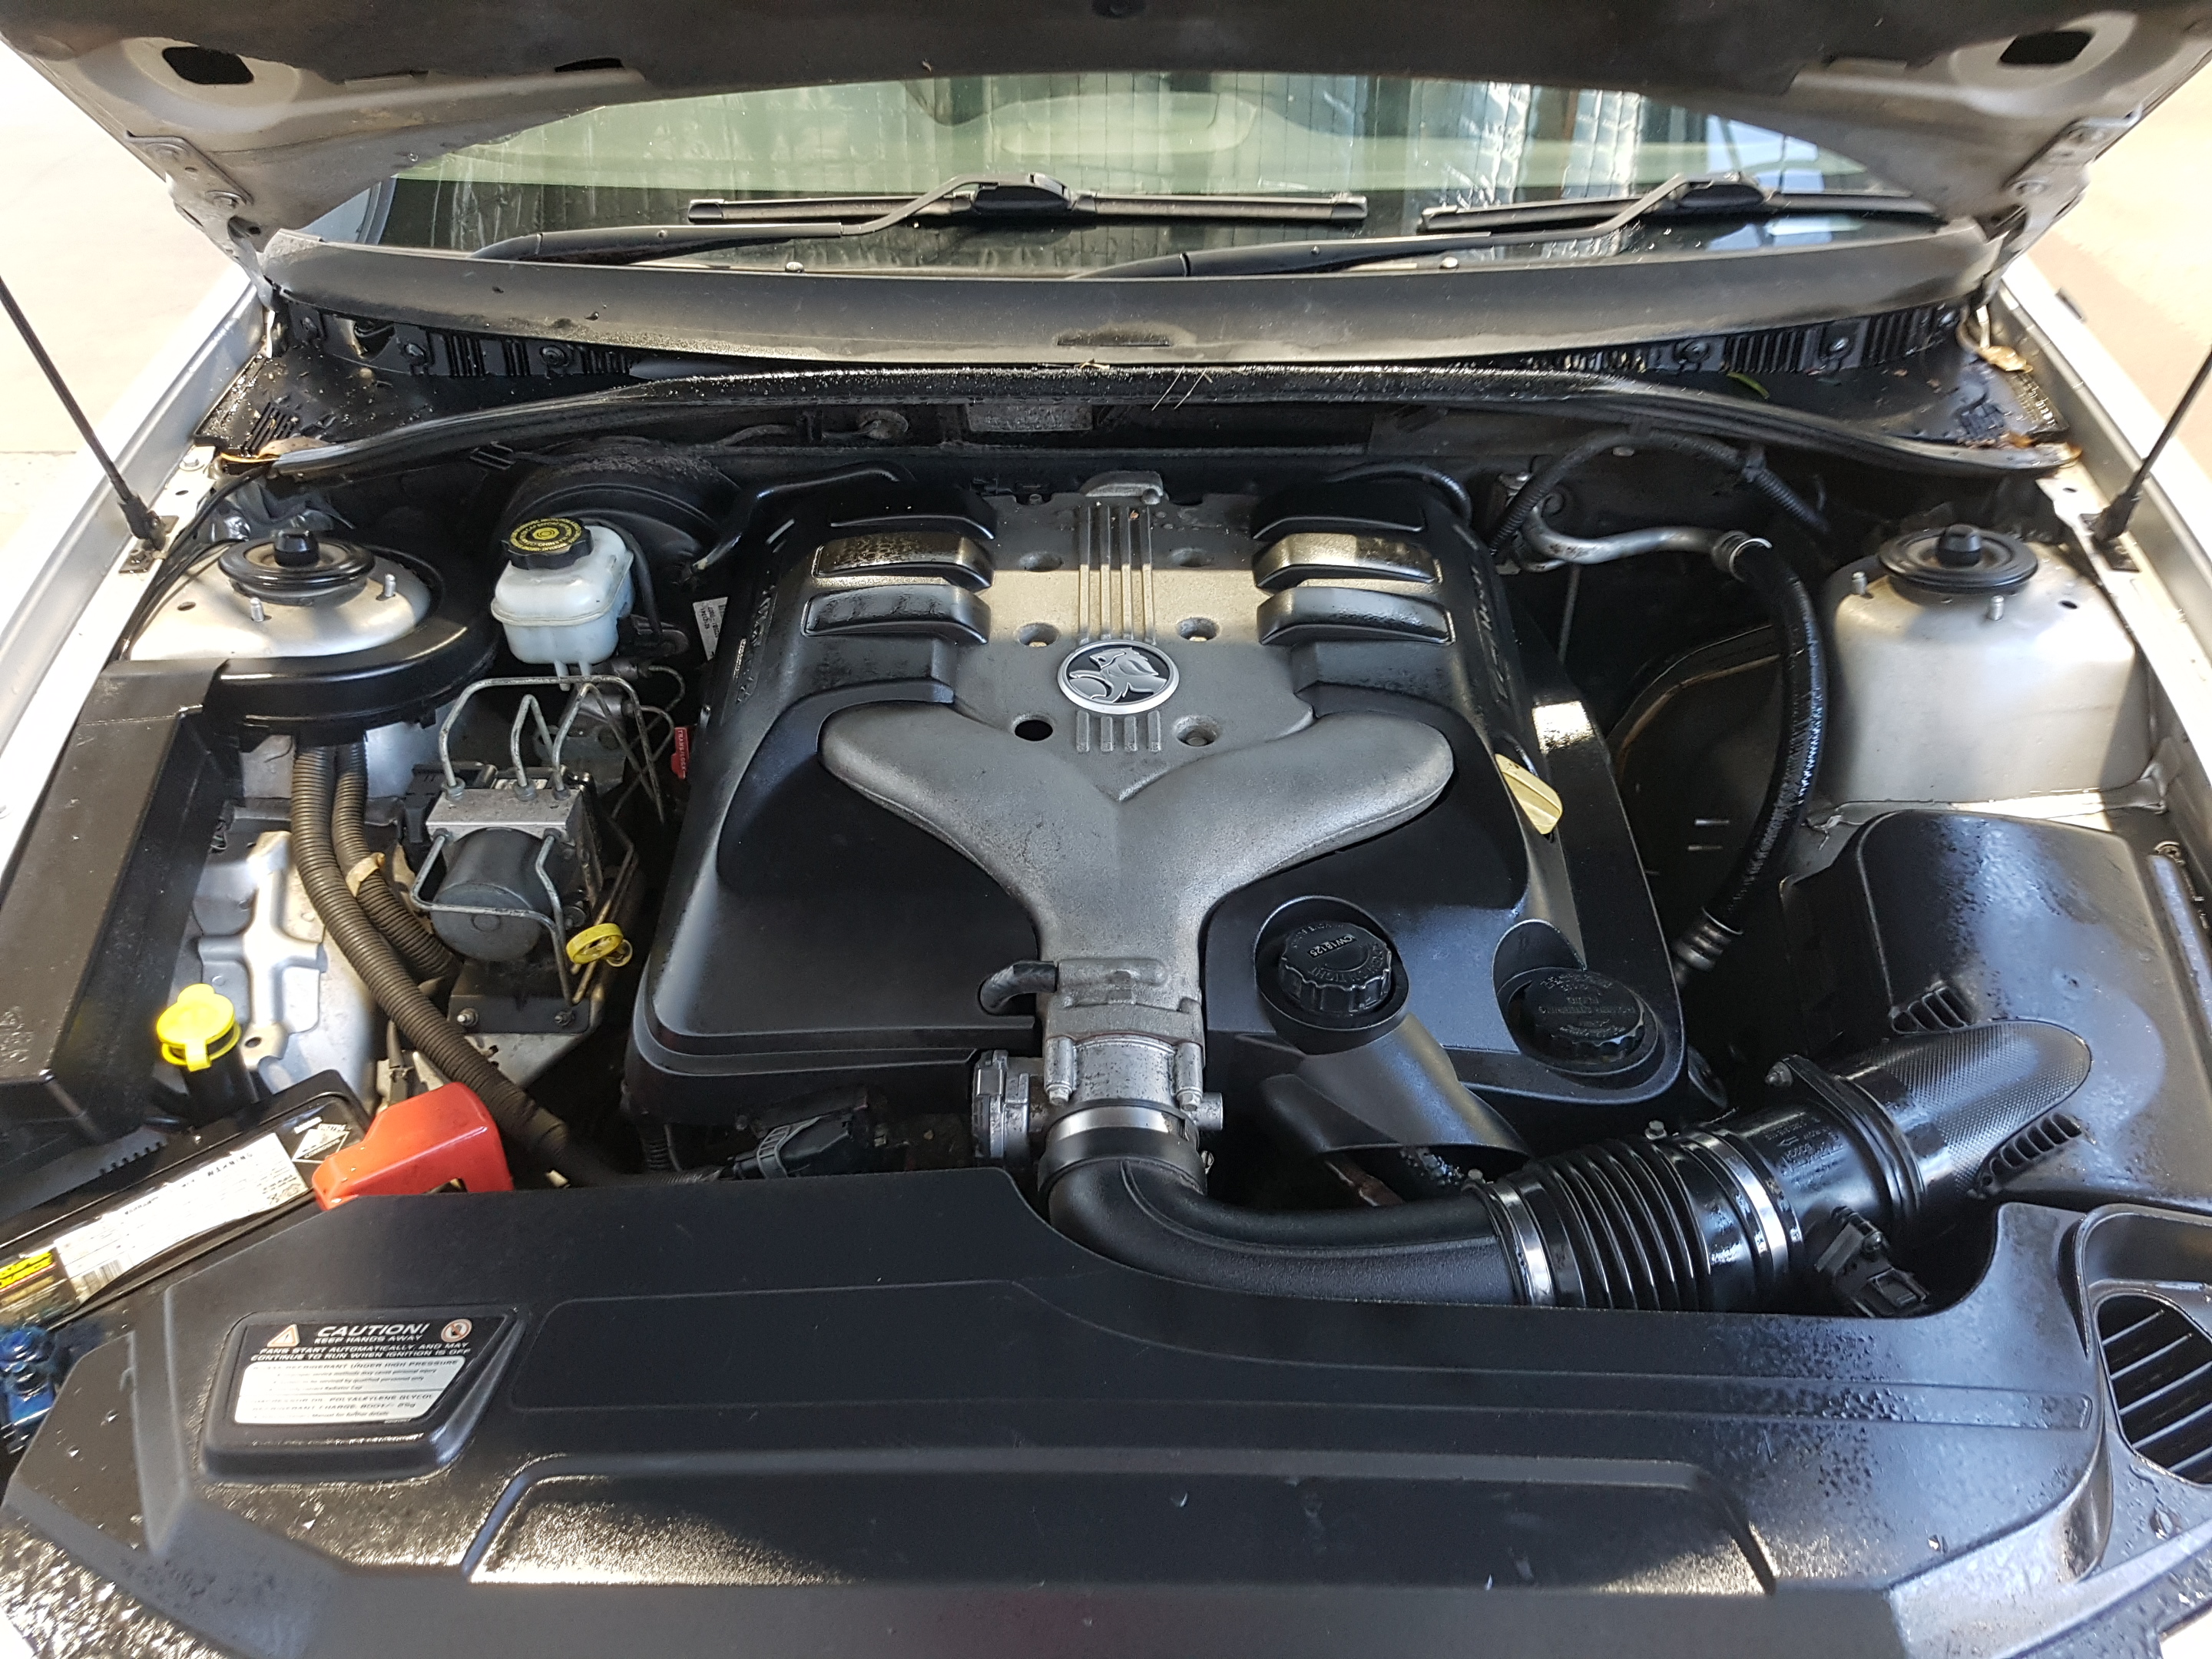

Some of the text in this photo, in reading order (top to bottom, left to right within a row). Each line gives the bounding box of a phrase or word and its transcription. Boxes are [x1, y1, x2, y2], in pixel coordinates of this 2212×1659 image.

[1310, 934, 1356, 956] CW18125
[317, 1323, 430, 1337] CAUTION!
[346, 1336, 386, 1344] HANDS
[387, 1334, 423, 1343] AWAY
[250, 1353, 307, 1362] CONTINUE
[386, 1349, 433, 1358] IGNITION
